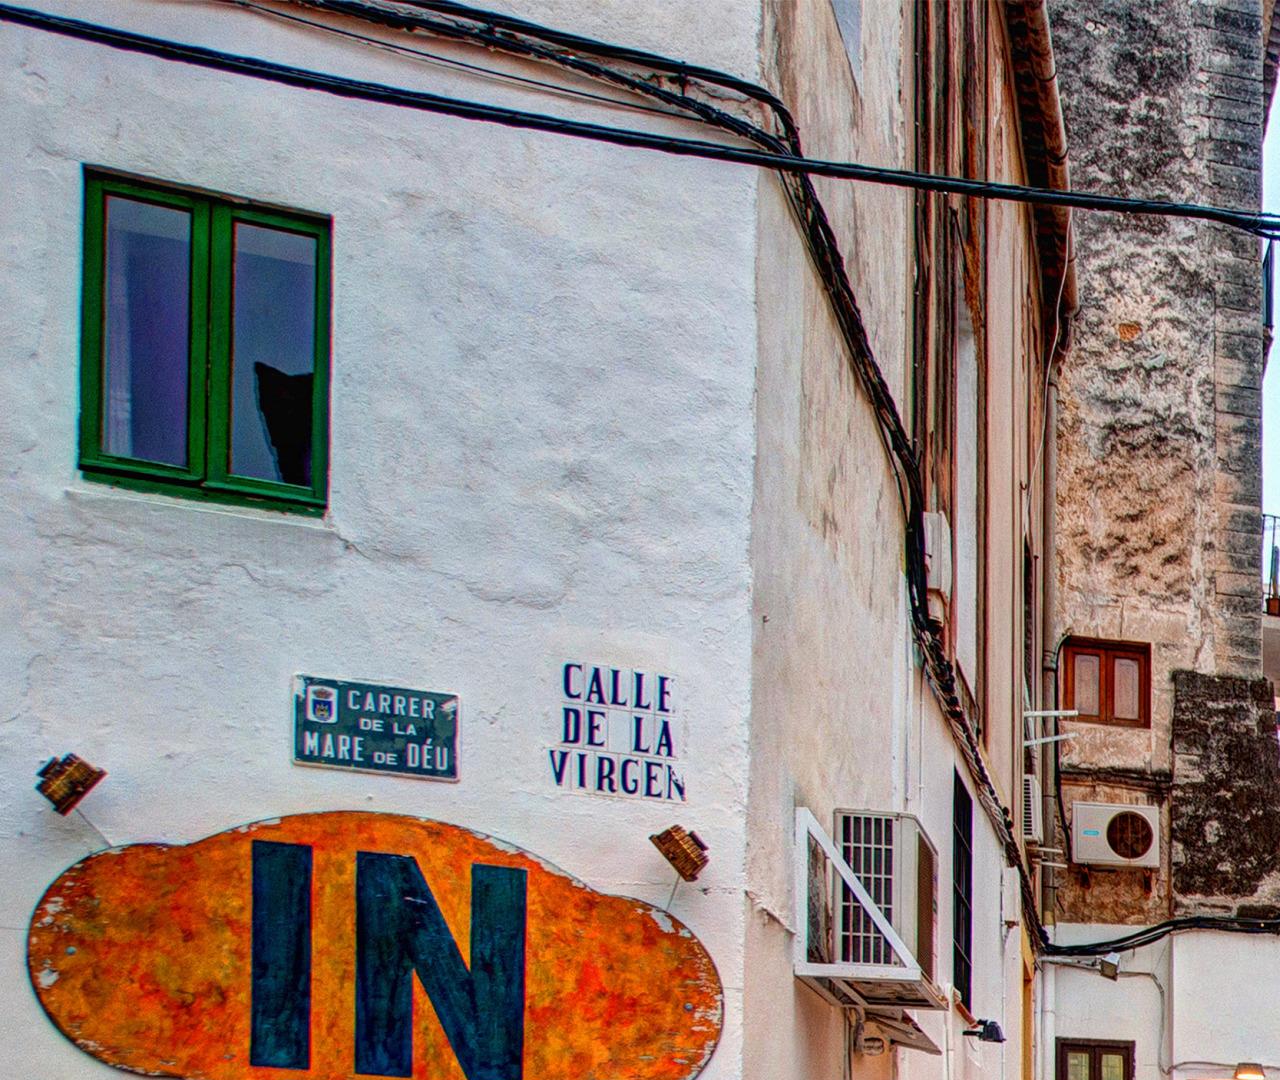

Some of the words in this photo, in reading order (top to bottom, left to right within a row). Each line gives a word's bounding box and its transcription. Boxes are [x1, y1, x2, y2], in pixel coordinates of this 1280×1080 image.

[347, 689, 435, 720] CARRER
[562, 663, 675, 713] CALLE
[359, 717, 384, 733] DE
[393, 721, 418, 737] LA
[562, 707, 606, 747] DE
[633, 715, 674, 759] LA
[303, 731, 364, 761] MARE
[373, 750, 398, 766] DE
[406, 738, 449, 771] DÉU
[548, 749, 688, 802] VIRGEN
